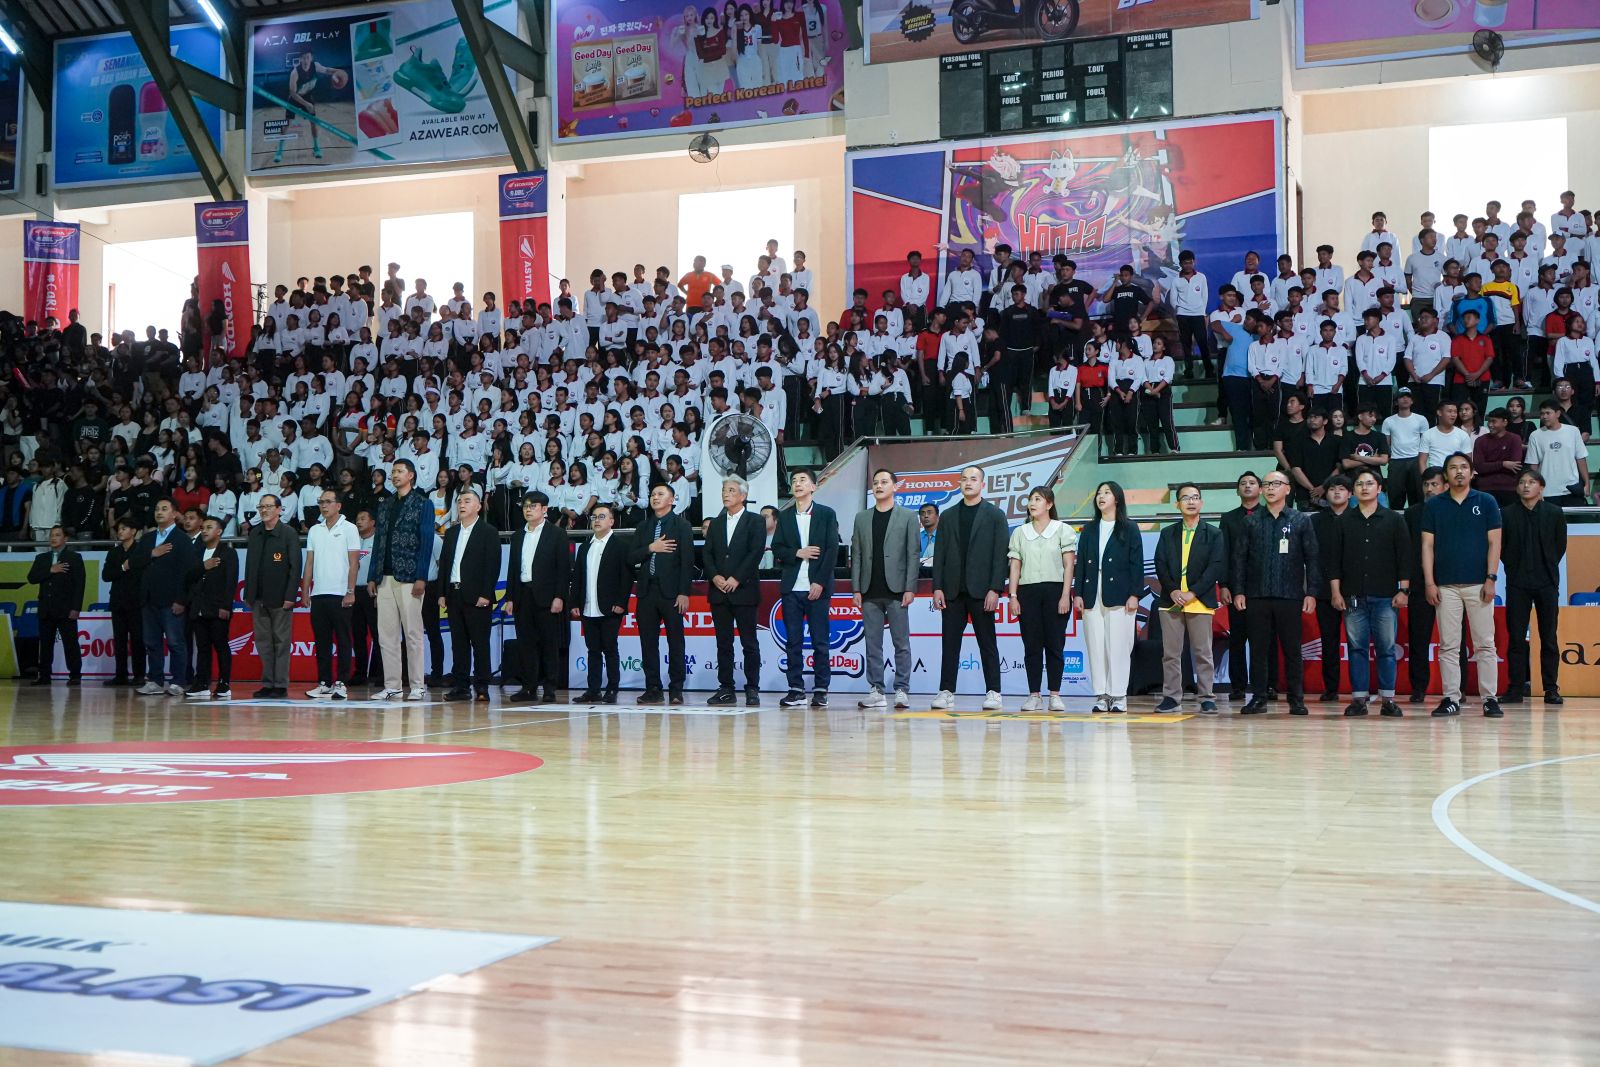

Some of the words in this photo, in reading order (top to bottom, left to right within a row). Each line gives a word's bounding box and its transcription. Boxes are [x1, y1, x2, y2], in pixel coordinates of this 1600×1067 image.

[293, 31, 312, 43] DBL
[315, 30, 340, 39] PLAY
[1127, 34, 1155, 43] PERSONAL
[1155, 32, 1169, 40] FOUL
[574, 50, 596, 61] Good
[596, 48, 612, 59] Day
[616, 43, 636, 55] Good
[636, 43, 652, 54] Day
[942, 55, 968, 63] PERSONAL
[968, 53, 981, 61] FOUL
[1042, 70, 1064, 79] PERIOD
[1088, 64, 1105, 73] T.OUT
[686, 92, 732, 108] Perfect
[735, 82, 785, 101] Korean
[787, 76, 827, 92] Latte!
[1040, 93, 1055, 102] TIME
[1055, 92, 1068, 100] OUT
[1086, 88, 1105, 96] FOULS
[1002, 96, 1020, 105] FOULS
[421, 117, 458, 125] AVAILABLE
[409, 123, 499, 141] AZAWEAR.COM
[1018, 213, 1107, 262] Honda
[524, 260, 533, 294] ASTRA
[905, 479, 953, 489] HONDA
[987, 471, 1032, 494] LET'S
[904, 494, 928, 506] DBL
[836, 655, 859, 671] Day
